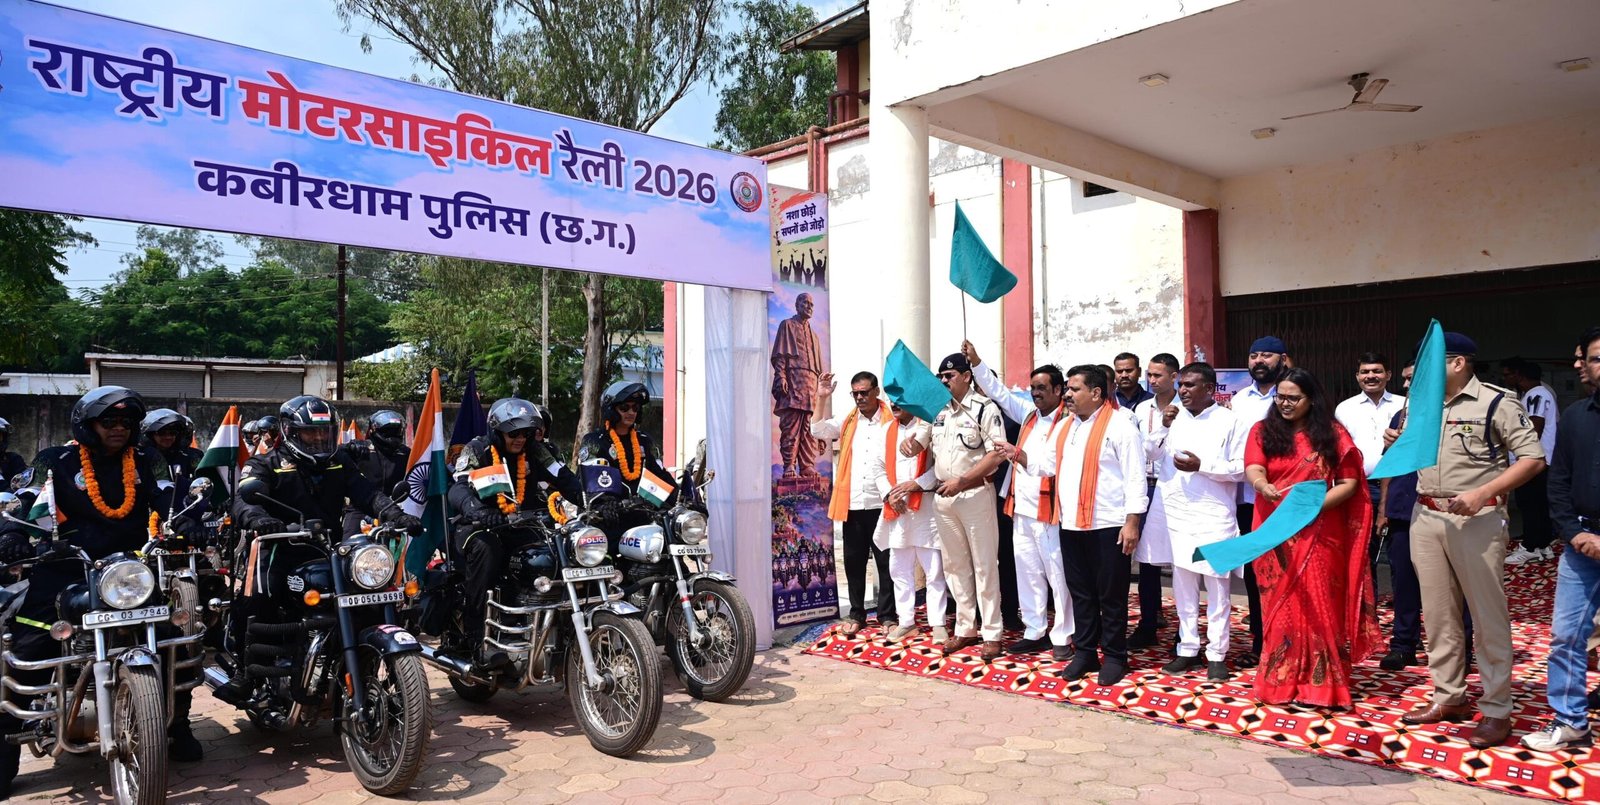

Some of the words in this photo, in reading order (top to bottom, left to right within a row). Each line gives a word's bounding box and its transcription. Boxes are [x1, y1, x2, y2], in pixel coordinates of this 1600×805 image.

[29, 39, 227, 118] राष्ट्रीय
[239, 70, 552, 175] मोटरसाइकिल
[554, 130, 625, 188] रैली
[634, 160, 716, 204] 2026
[194, 161, 412, 220] कबीरधाम
[420, 191, 530, 239] पुलिस
[540, 211, 636, 254] (छ.ग.)
[785, 209, 799, 220] नशा
[800, 203, 816, 218] छोड़ो
[781, 222, 799, 236] सपनों
[800, 220, 808, 232] को
[810, 216, 824, 231] जोड़ो
[580, 536, 607, 545] POLICE
[120, 610, 133, 620] 03
[143, 607, 168, 617] 7943
